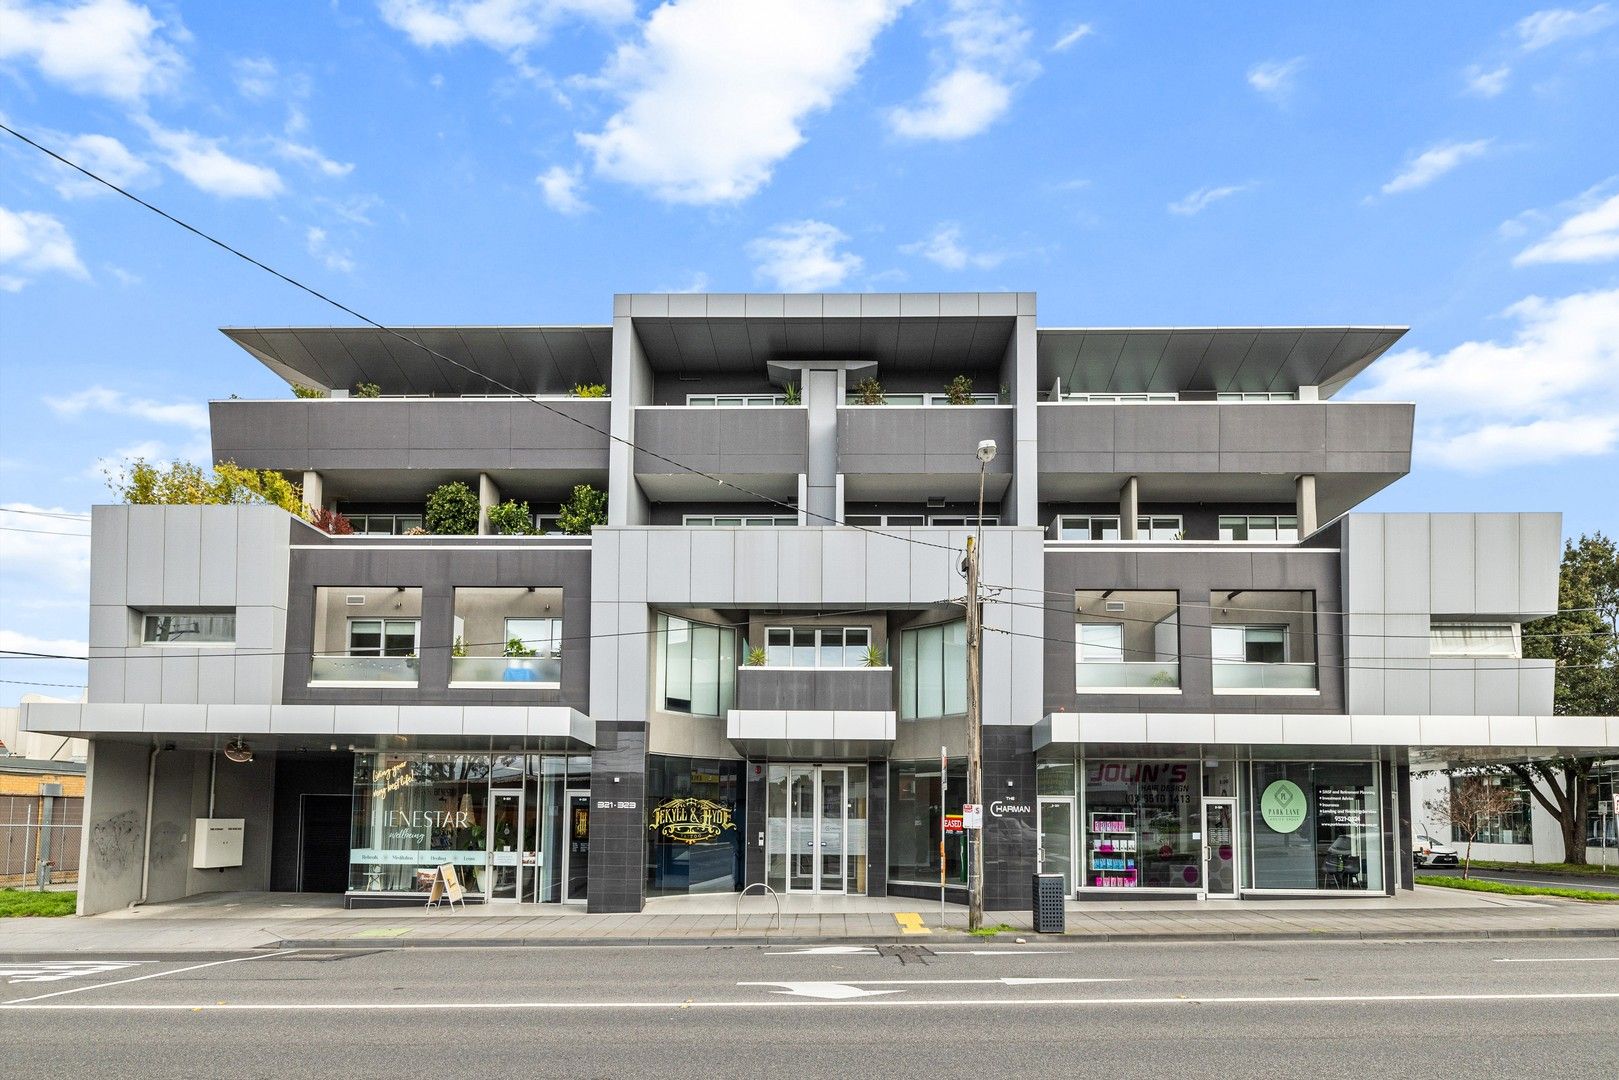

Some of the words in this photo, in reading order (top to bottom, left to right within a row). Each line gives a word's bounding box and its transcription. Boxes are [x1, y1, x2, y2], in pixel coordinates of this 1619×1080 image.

[1091, 763, 1188, 783] JOLIN'S
[1142, 784, 1159, 792] HAIR
[1160, 784, 1190, 792] DESIGN
[1268, 808, 1284, 816] PARK
[1285, 808, 1300, 816] LANE
[700, 807, 737, 831] HYDE
[944, 819, 962, 828] EASED
[389, 827, 425, 844] wellbeing
